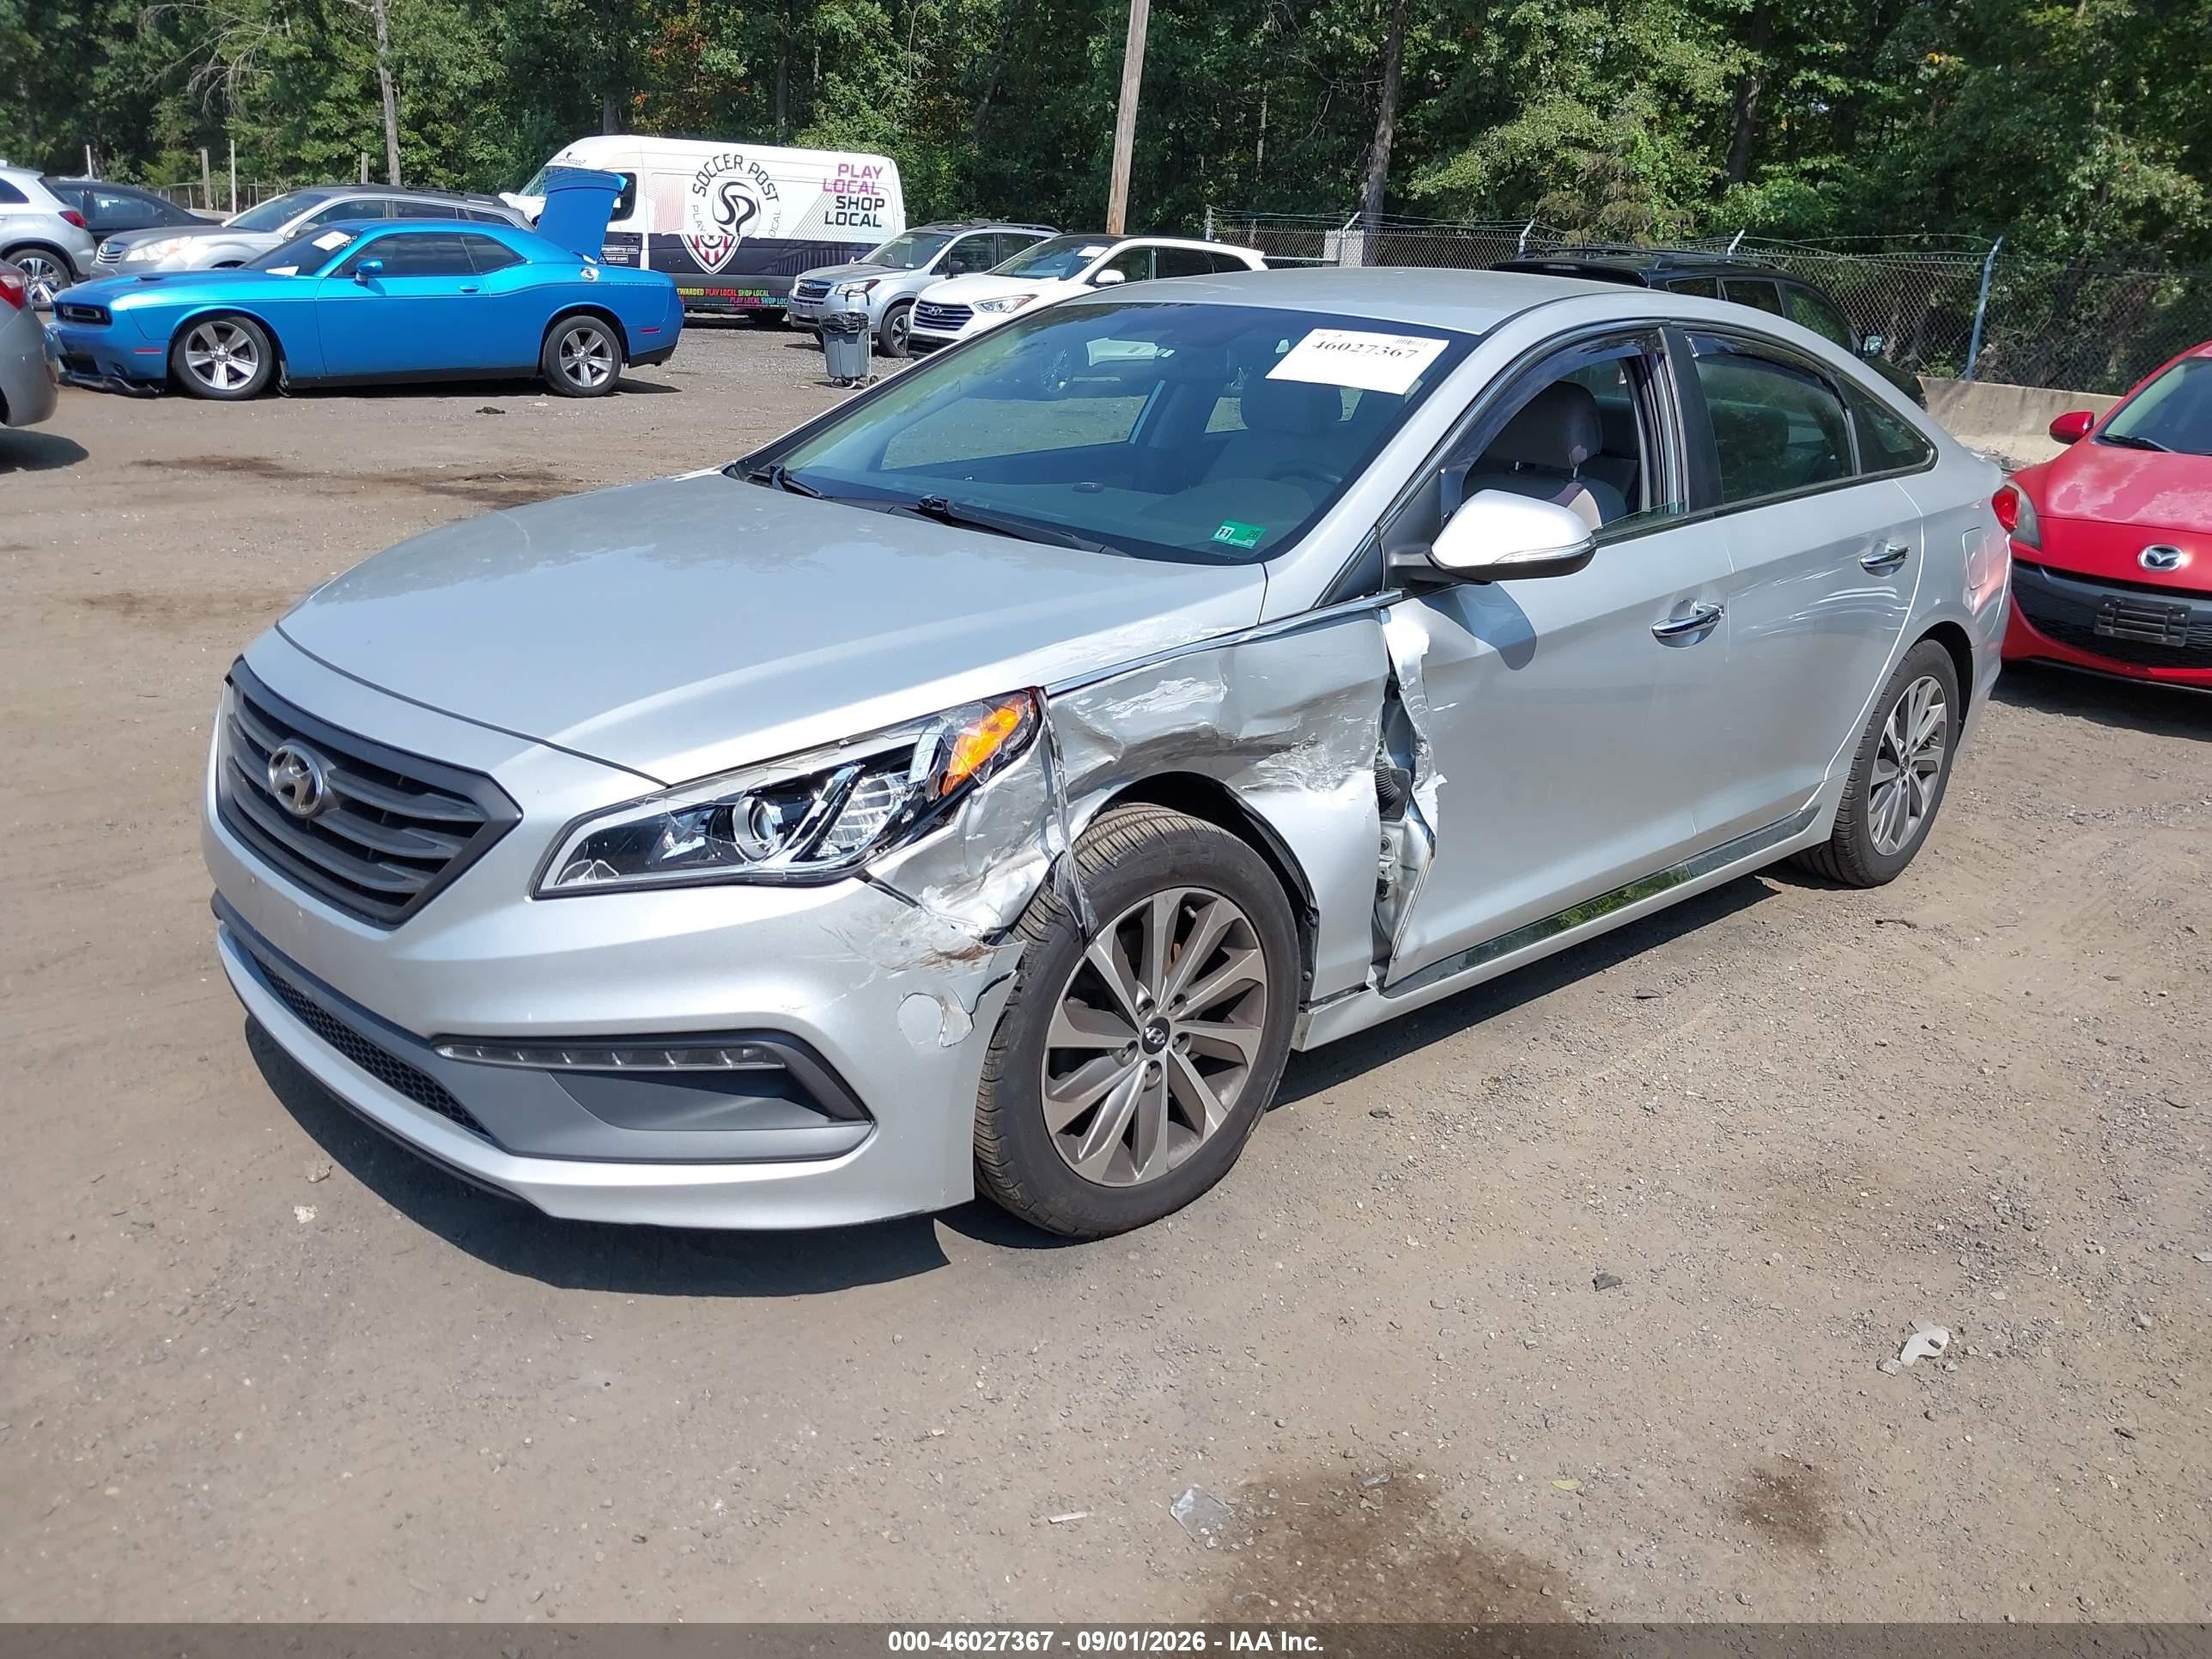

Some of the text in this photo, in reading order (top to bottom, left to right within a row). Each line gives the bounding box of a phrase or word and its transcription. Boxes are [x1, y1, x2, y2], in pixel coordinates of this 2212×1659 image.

[692, 153, 780, 202] SOCCER POST
[838, 163, 883, 179] PLAY
[823, 178, 880, 195] LOCAL
[836, 195, 885, 211] SHOP
[691, 204, 707, 232] PLAY
[768, 208, 781, 237] OCAL
[824, 210, 882, 228] LOCAL
[677, 288, 704, 296] EWARDED
[705, 288, 720, 296] PLAY
[738, 289, 752, 297] SHOP
[1312, 340, 1419, 360] 46027367
[1218, 527, 1232, 538] 11
